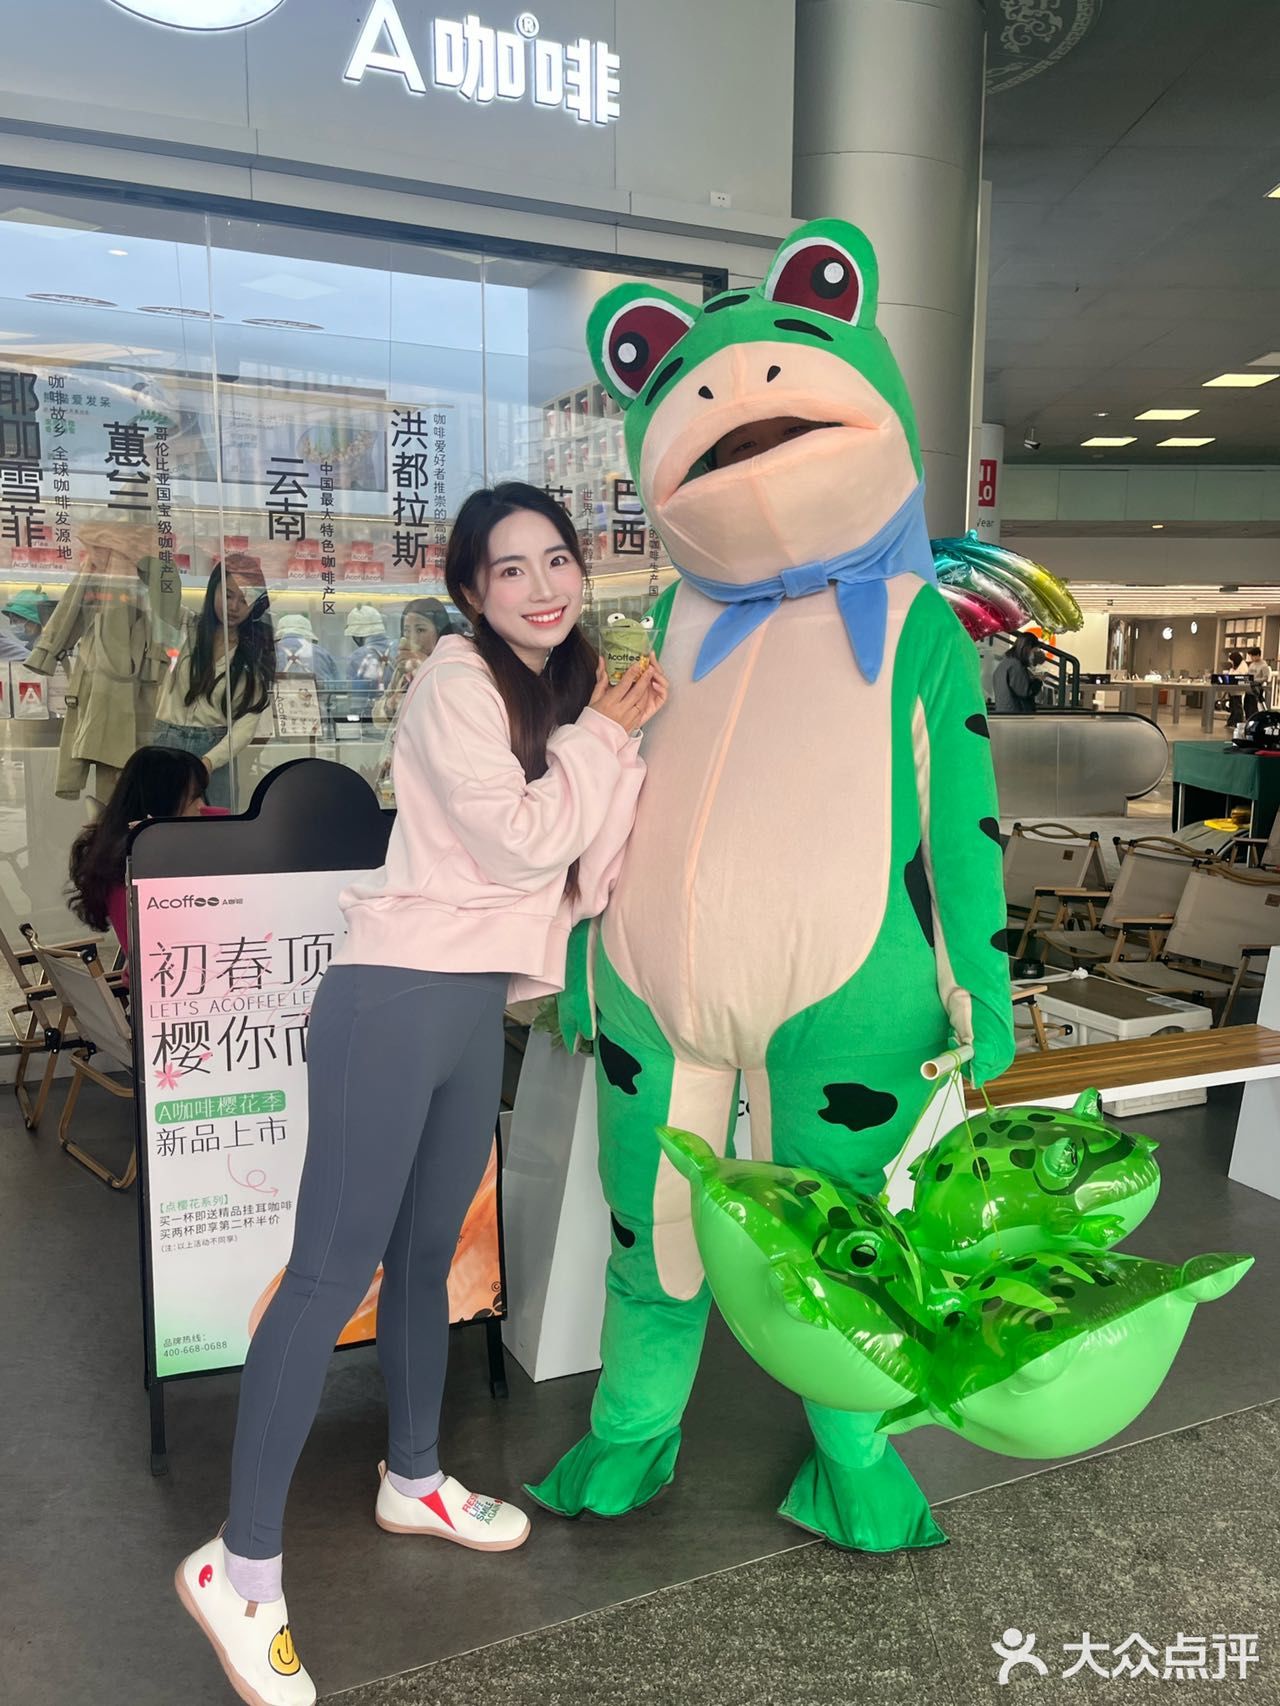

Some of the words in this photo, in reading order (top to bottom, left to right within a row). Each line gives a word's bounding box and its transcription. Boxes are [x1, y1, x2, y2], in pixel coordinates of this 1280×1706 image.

[51, 445, 73, 560] 全球咖啡发源地
[154, 426, 174, 594] 哥伦比亚国宝级咖啡产区
[265, 457, 309, 541] 云南
[391, 409, 429, 569] 洪都拉斯
[612, 478, 646, 555] 巴西
[319, 461, 337, 615] 中国最大特色咖啡产区
[149, 933, 348, 998] 初春顶
[149, 1000, 200, 1019] LET'S
[209, 993, 290, 1014] ACOFFEE
[156, 1116, 288, 1157] 新品上市
[158, 1092, 283, 1121] A咖啡樱花季
[160, 1200, 293, 1227] 买一杯即送精品挂耳咖啡
[160, 1214, 281, 1241] 买两杯即享第二杯半价
[163, 1340, 228, 1357] 400-668-0688
